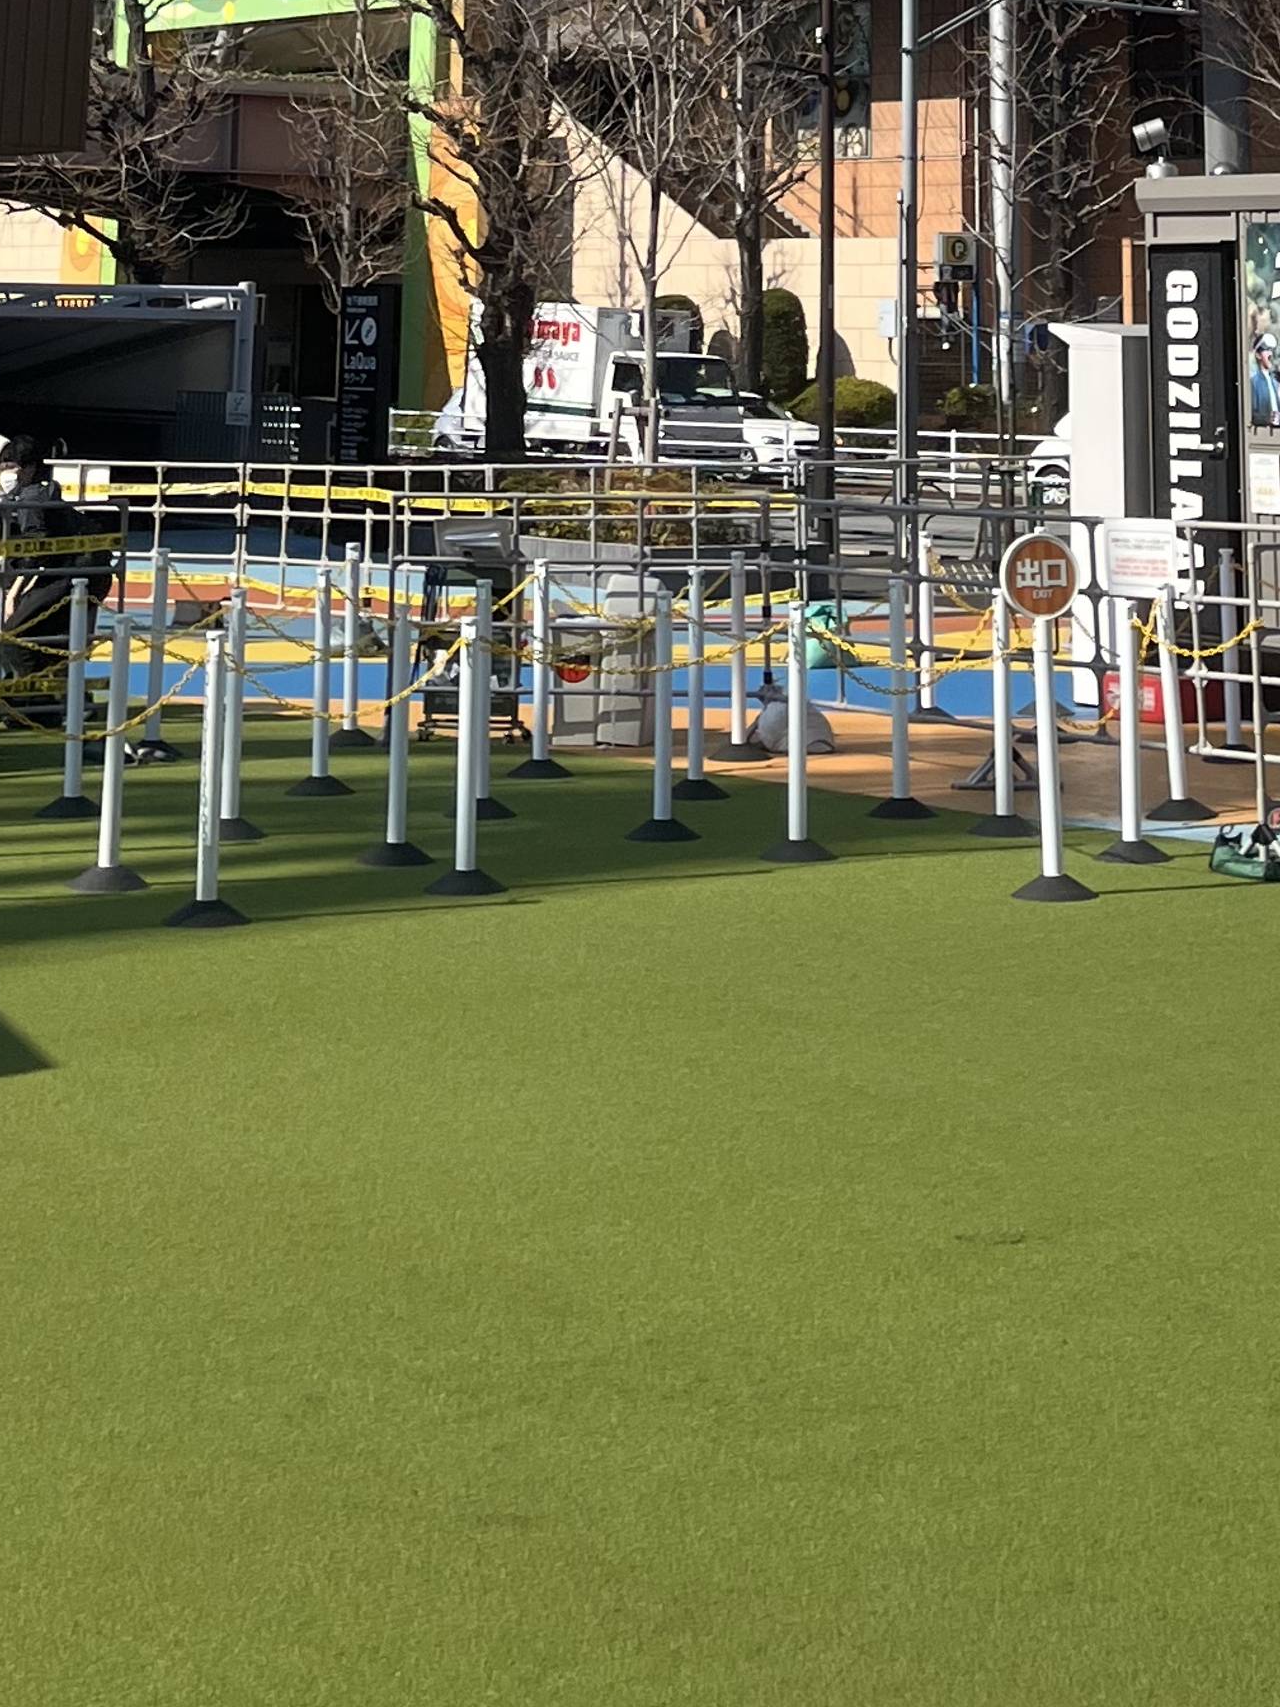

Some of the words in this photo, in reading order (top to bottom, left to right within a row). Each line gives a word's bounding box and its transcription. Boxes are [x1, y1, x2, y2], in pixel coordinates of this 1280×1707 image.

[344, 351, 376, 370] LaQua
[1166, 269, 1203, 521] GODZILLA
[1016, 558, 1067, 588] 出口
